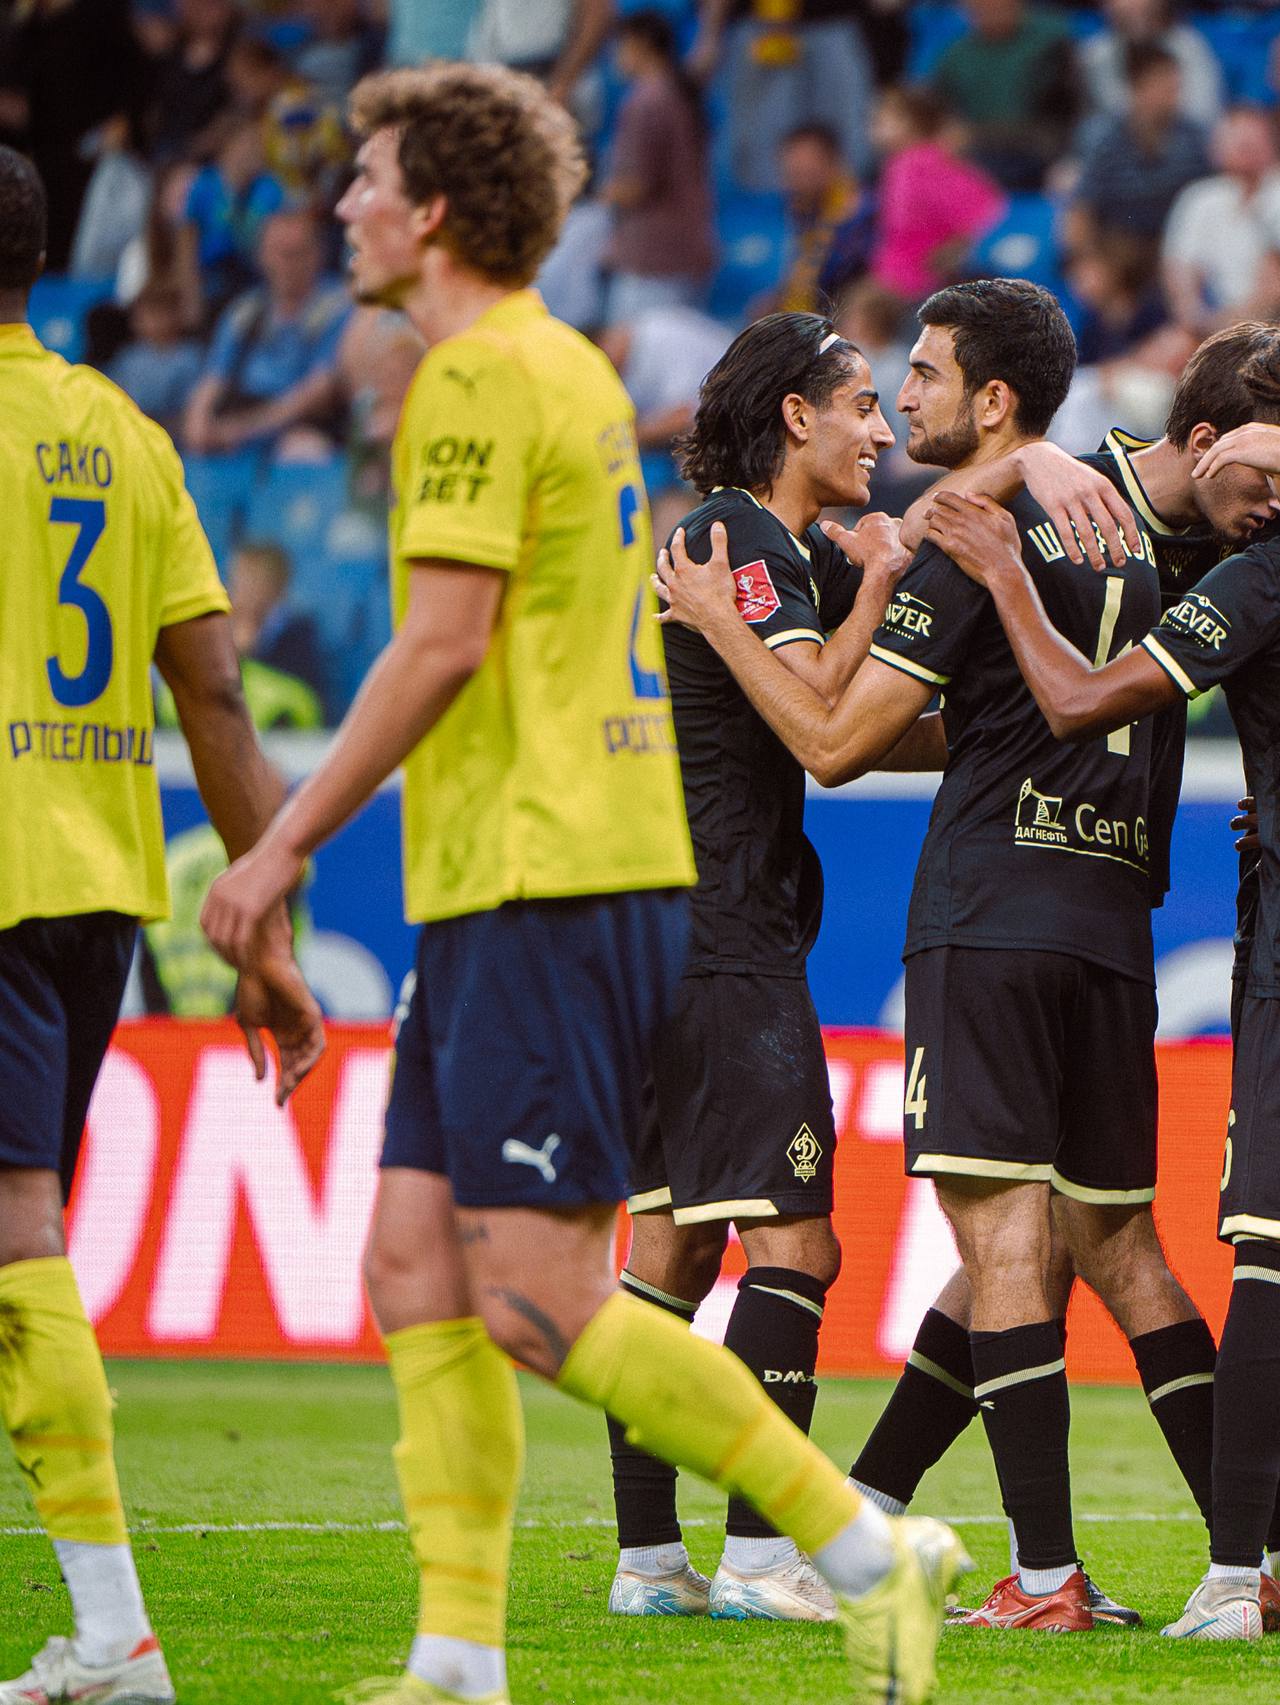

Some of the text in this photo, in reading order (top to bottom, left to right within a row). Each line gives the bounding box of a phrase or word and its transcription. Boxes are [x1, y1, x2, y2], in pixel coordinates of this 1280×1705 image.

[424, 437, 495, 467] ON
[46, 495, 114, 708] 3
[1014, 825, 1068, 844] ДАГНЕФТЬ
[1075, 802, 1129, 849] Cen
[904, 1046, 929, 1130] 4
